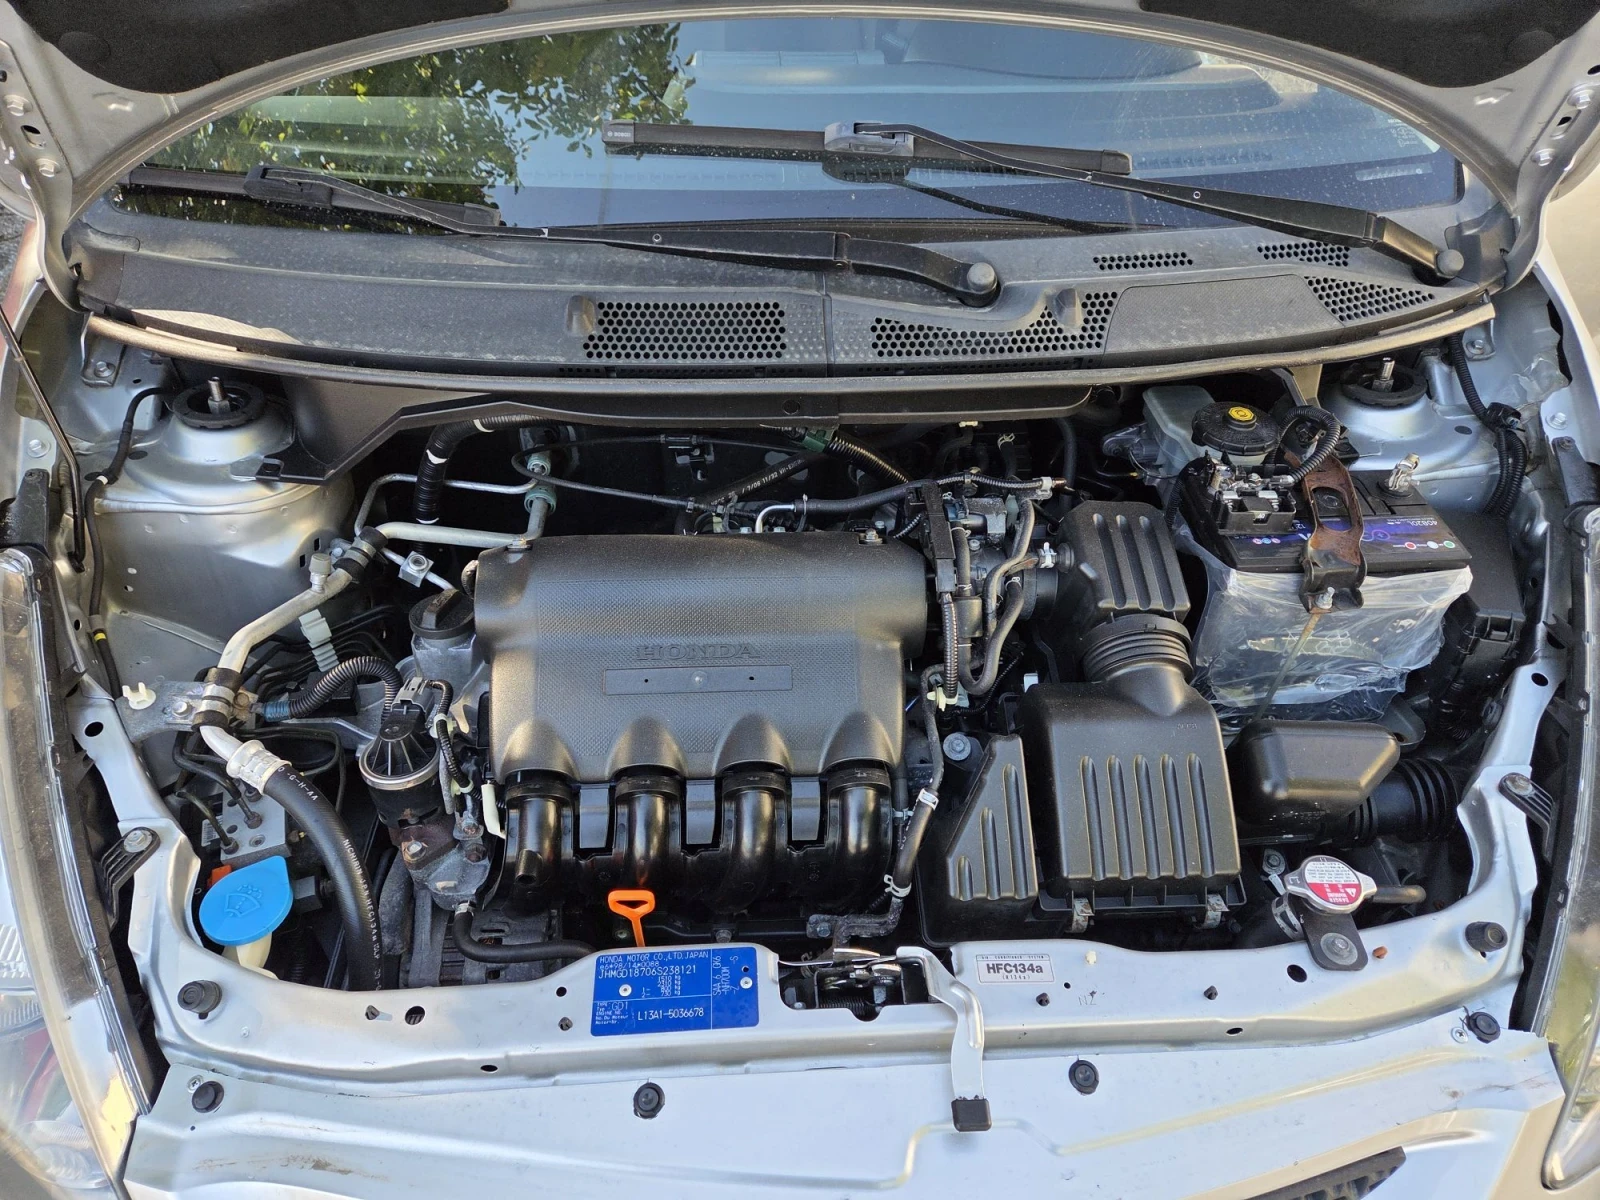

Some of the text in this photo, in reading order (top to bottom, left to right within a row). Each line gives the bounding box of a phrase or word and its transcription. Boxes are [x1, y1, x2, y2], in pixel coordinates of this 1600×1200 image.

[636, 644, 761, 661] HONDA
[342, 838, 363, 875] NICHIRIN
[599, 955, 623, 964] HONDA
[626, 953, 650, 962] MOTOR
[598, 965, 696, 979] JHMGD18706S238121
[986, 962, 1044, 974] HFC134a
[713, 982, 722, 996] SAA
[611, 1001, 629, 1012] GD1
[637, 1007, 704, 1020] L13A1-5036678
